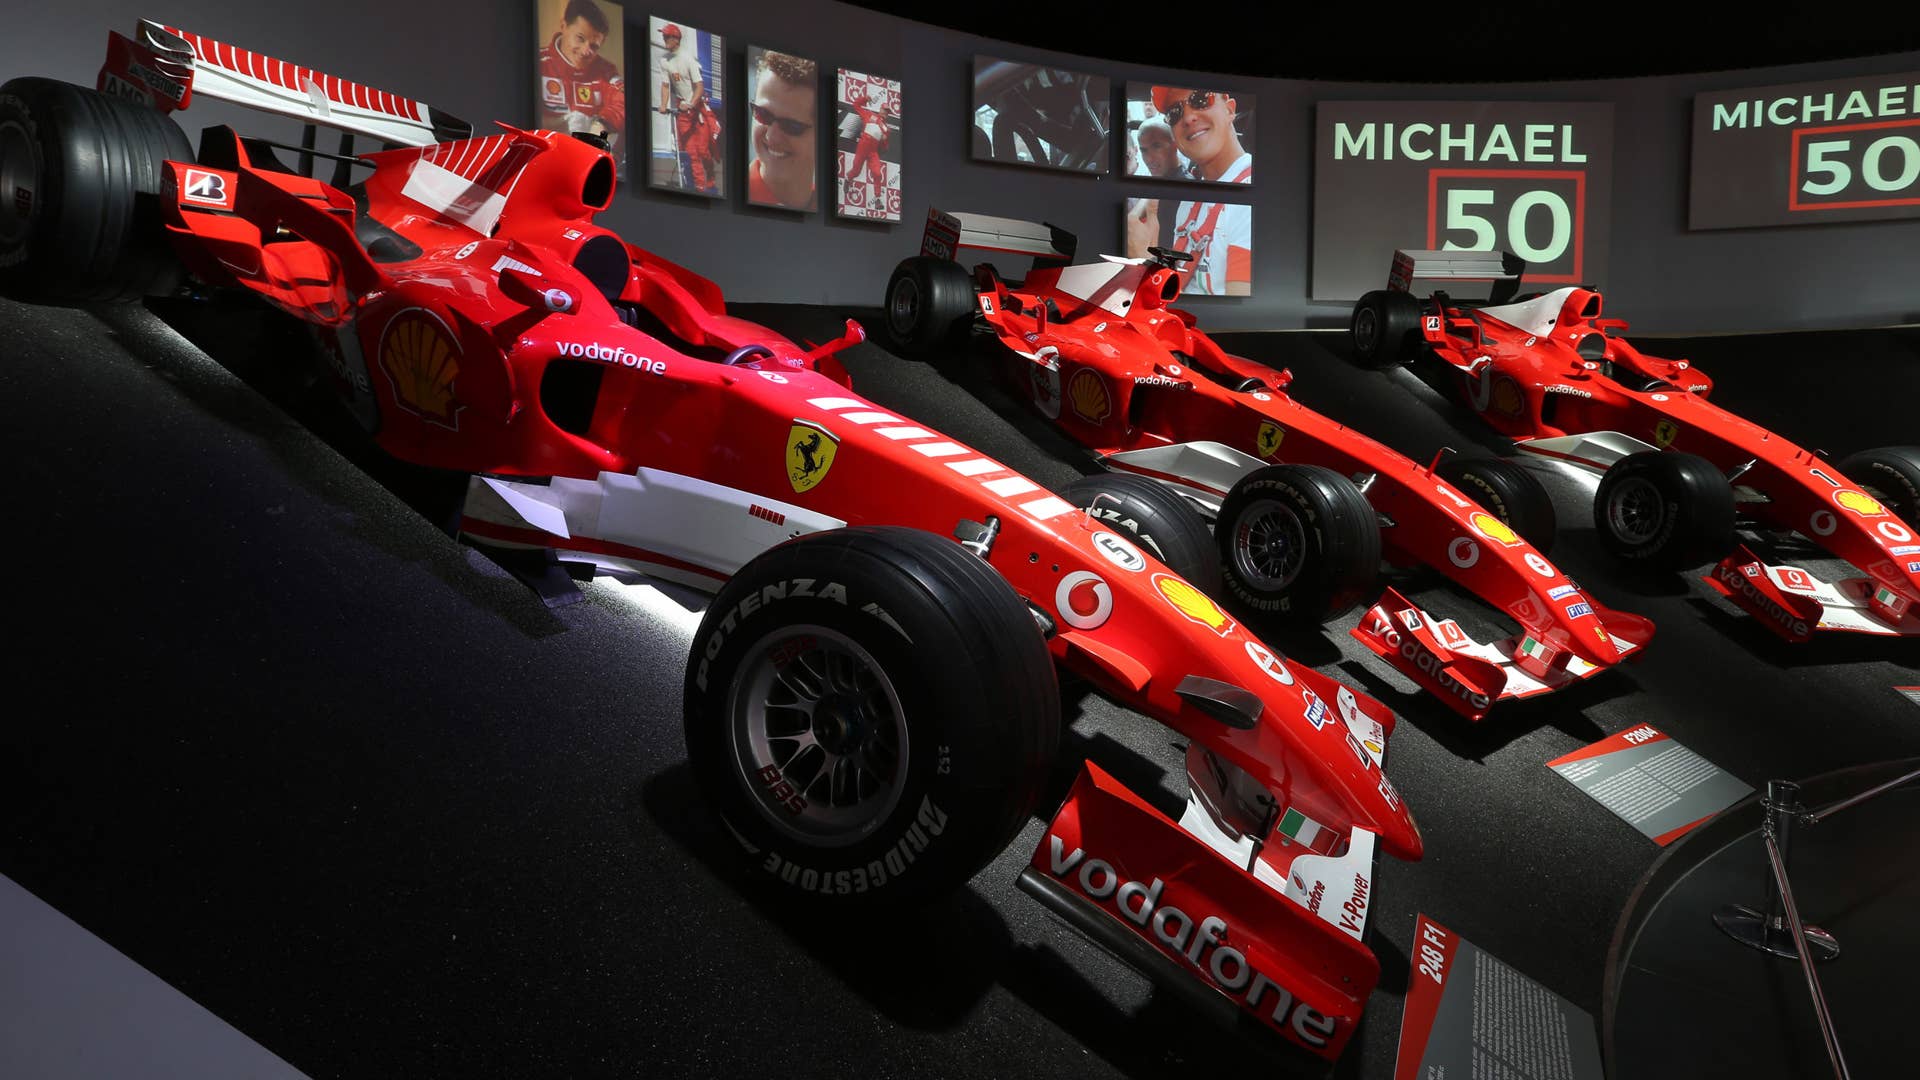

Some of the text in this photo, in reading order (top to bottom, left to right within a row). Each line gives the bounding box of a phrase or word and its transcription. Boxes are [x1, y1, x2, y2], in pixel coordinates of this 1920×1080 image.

[1333, 122, 1588, 163] MICHAEL
[1802, 135, 1920, 196] 50
[1441, 188, 1572, 263] 50
[555, 341, 667, 375] vodafone
[1543, 384, 1592, 399] vodafone
[1099, 537, 1138, 566] 5
[696, 578, 849, 693] POTENZA
[1622, 725, 1660, 745] F2004
[757, 763, 808, 816] BBS
[763, 793, 949, 895] BRIDGESTONE
[1339, 872, 1369, 932] V-Power
[1050, 834, 1336, 1046] vodafone
[1418, 922, 1447, 985] 248 F1
